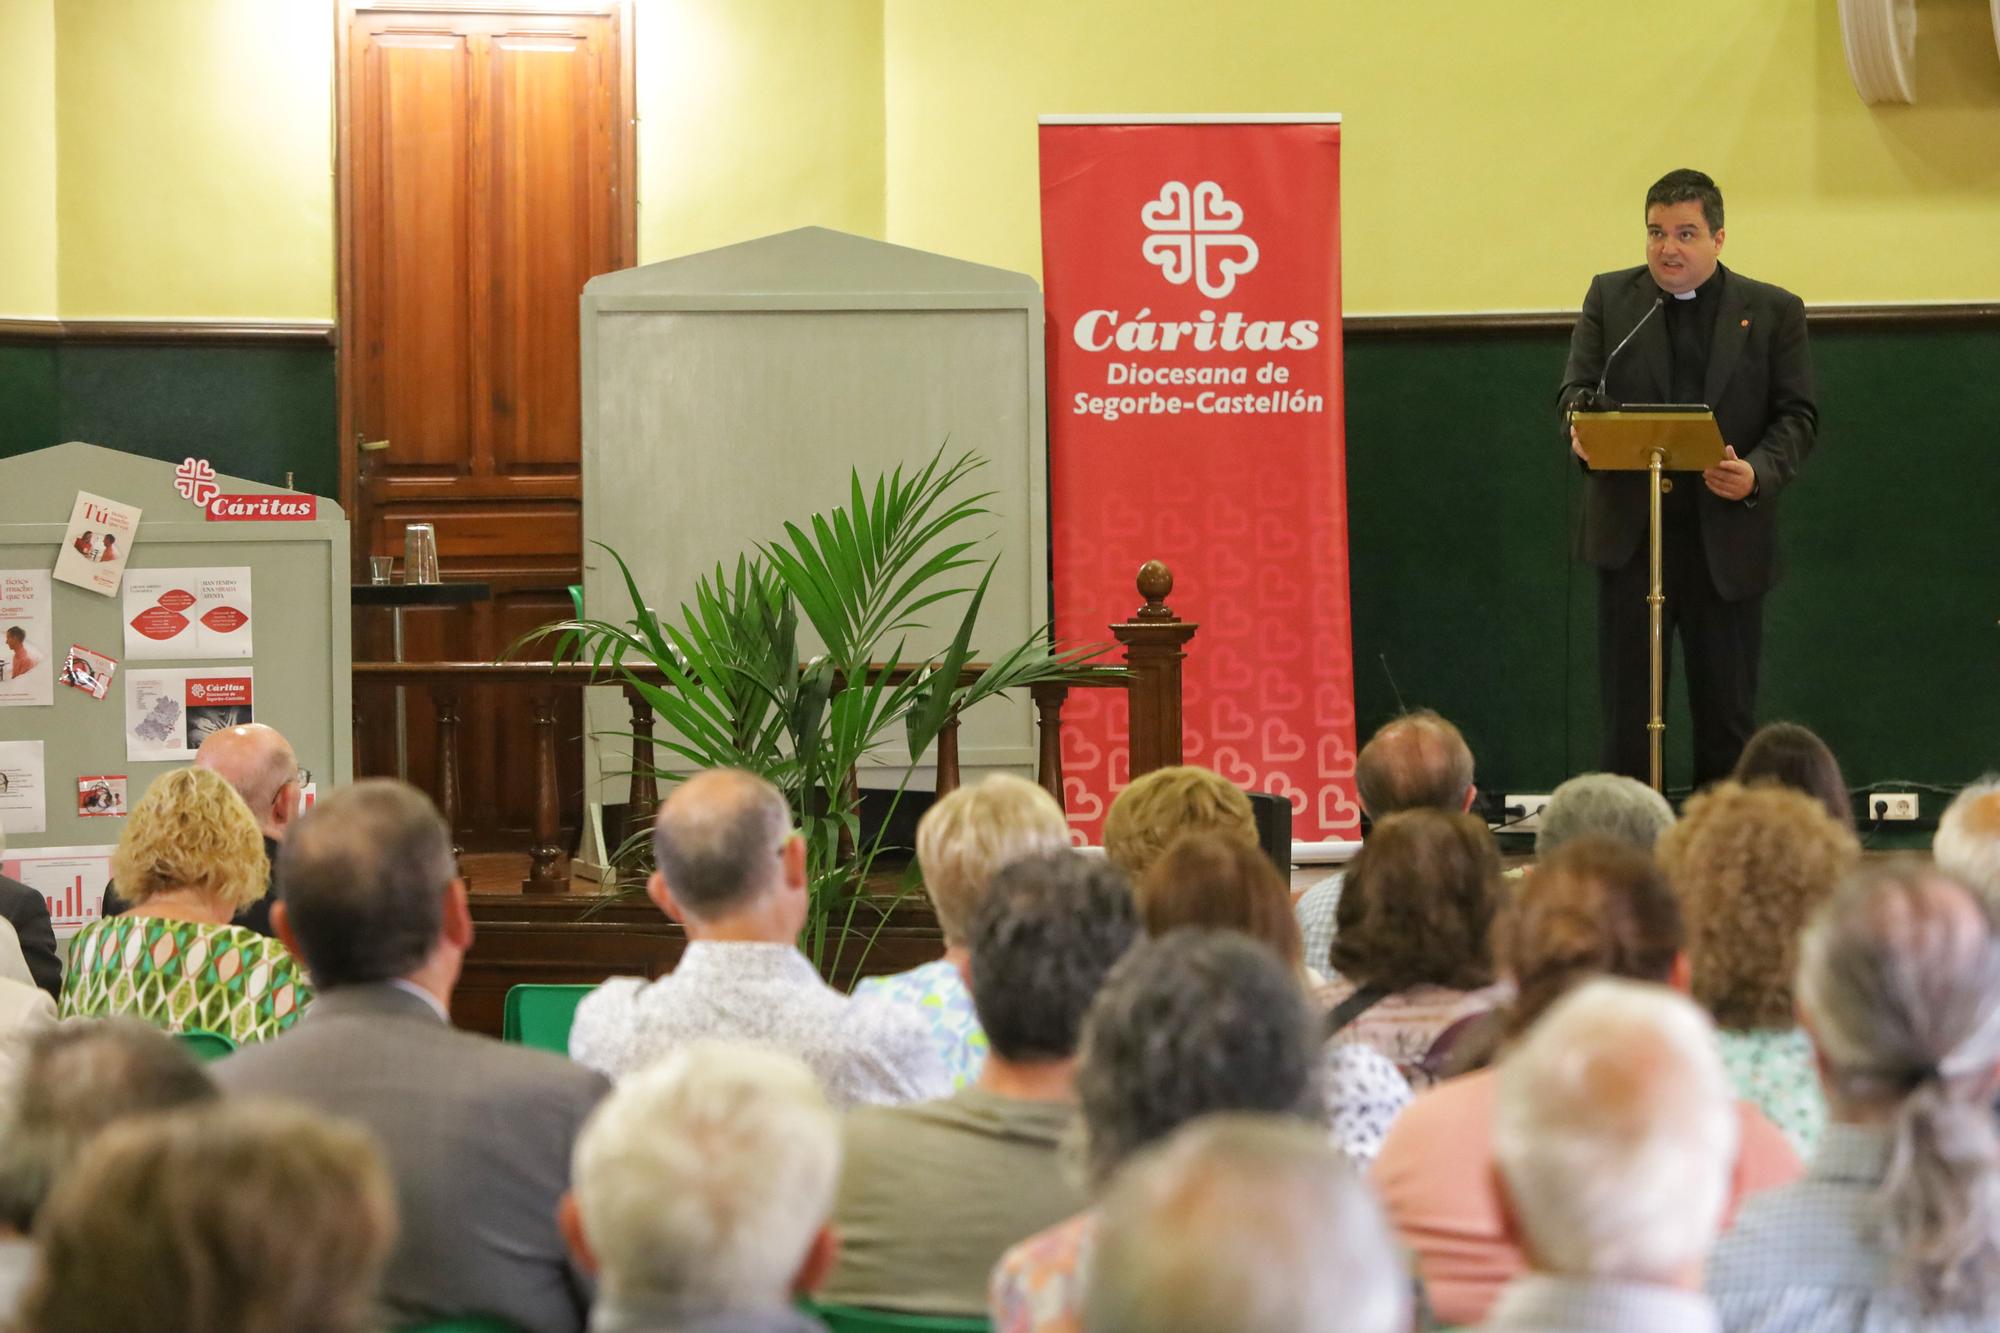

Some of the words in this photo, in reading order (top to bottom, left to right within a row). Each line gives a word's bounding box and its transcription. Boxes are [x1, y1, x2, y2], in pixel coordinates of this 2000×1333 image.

[1073, 308, 1320, 352] Cáritas
[1107, 363, 1247, 385] Diocesana
[1256, 362, 1289, 384] de
[1073, 389, 1323, 421] Segorbe-Castellón
[84, 502, 109, 525] Tú
[211, 498, 311, 516] Cáritas
